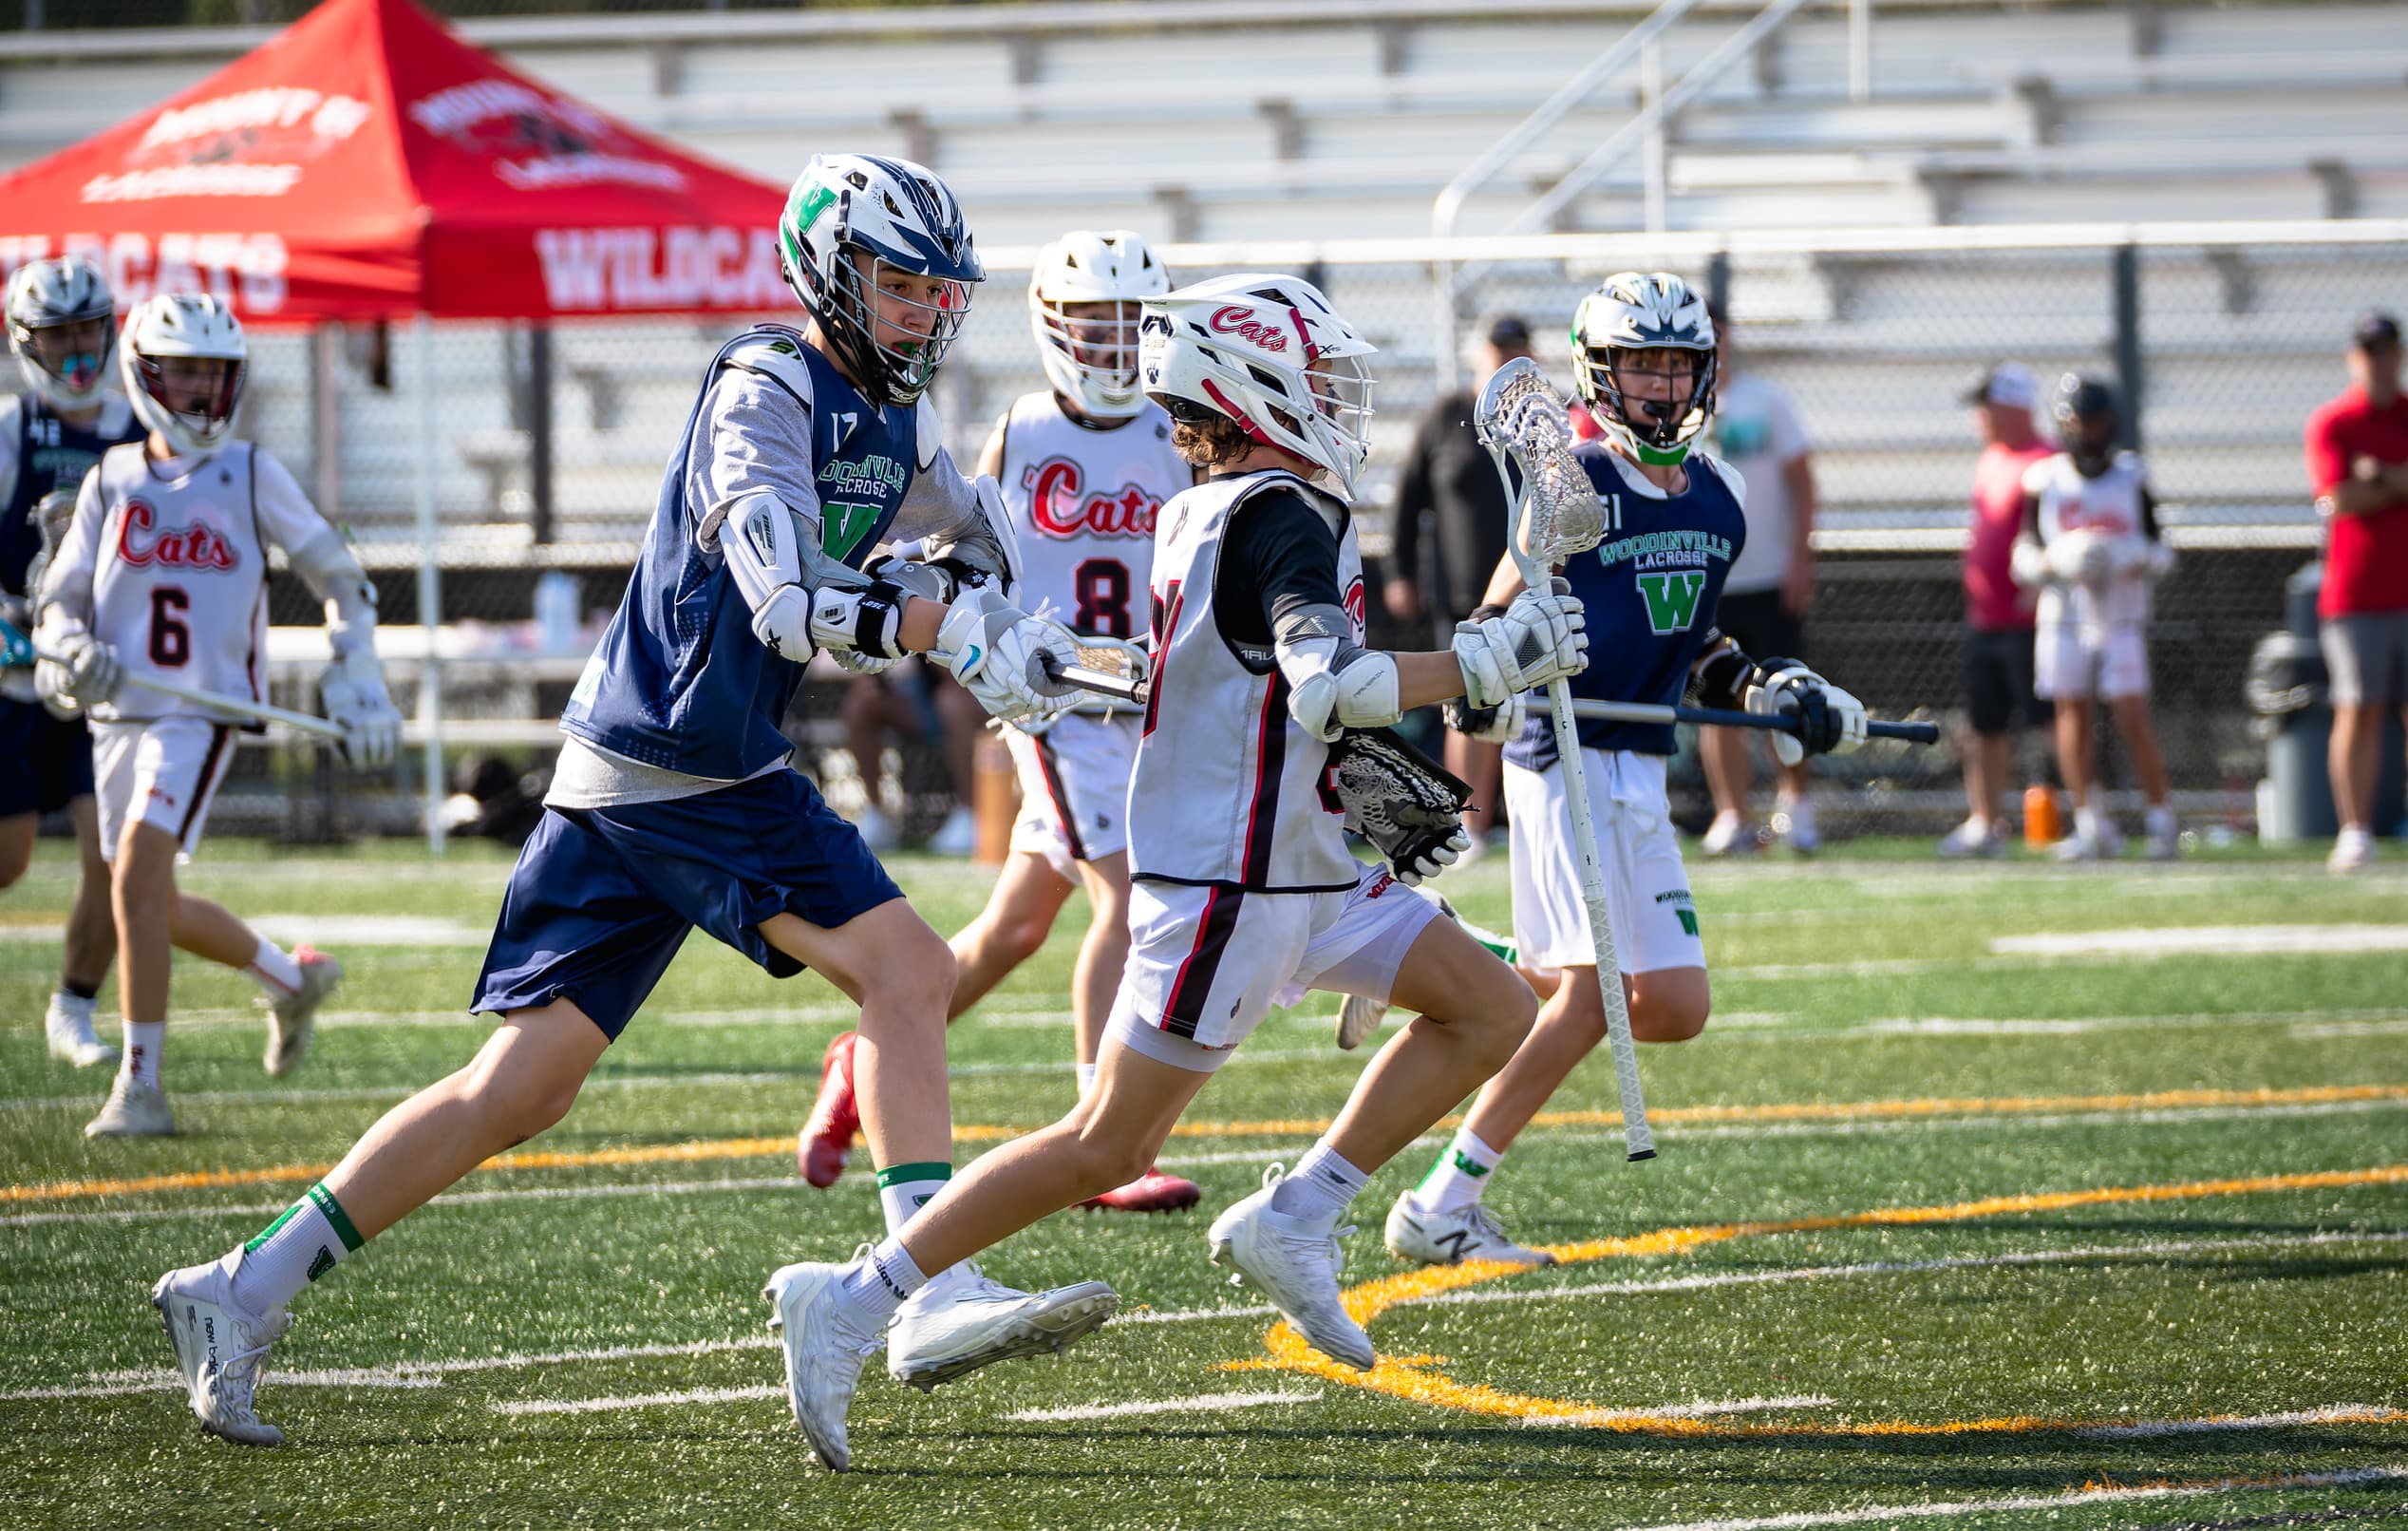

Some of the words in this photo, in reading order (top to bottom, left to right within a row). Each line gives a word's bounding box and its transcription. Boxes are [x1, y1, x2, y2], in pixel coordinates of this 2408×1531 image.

[534, 227, 805, 310] WILDCA
[1209, 305, 1288, 352] Cats
[831, 412, 857, 453] 17
[116, 495, 240, 574] Cats
[1598, 530, 1733, 568] WOODINVILLE
[1634, 550, 1710, 570] LACROSSE
[148, 583, 192, 669] 6
[1074, 558, 1131, 638] 8
[1635, 570, 1707, 635] W
